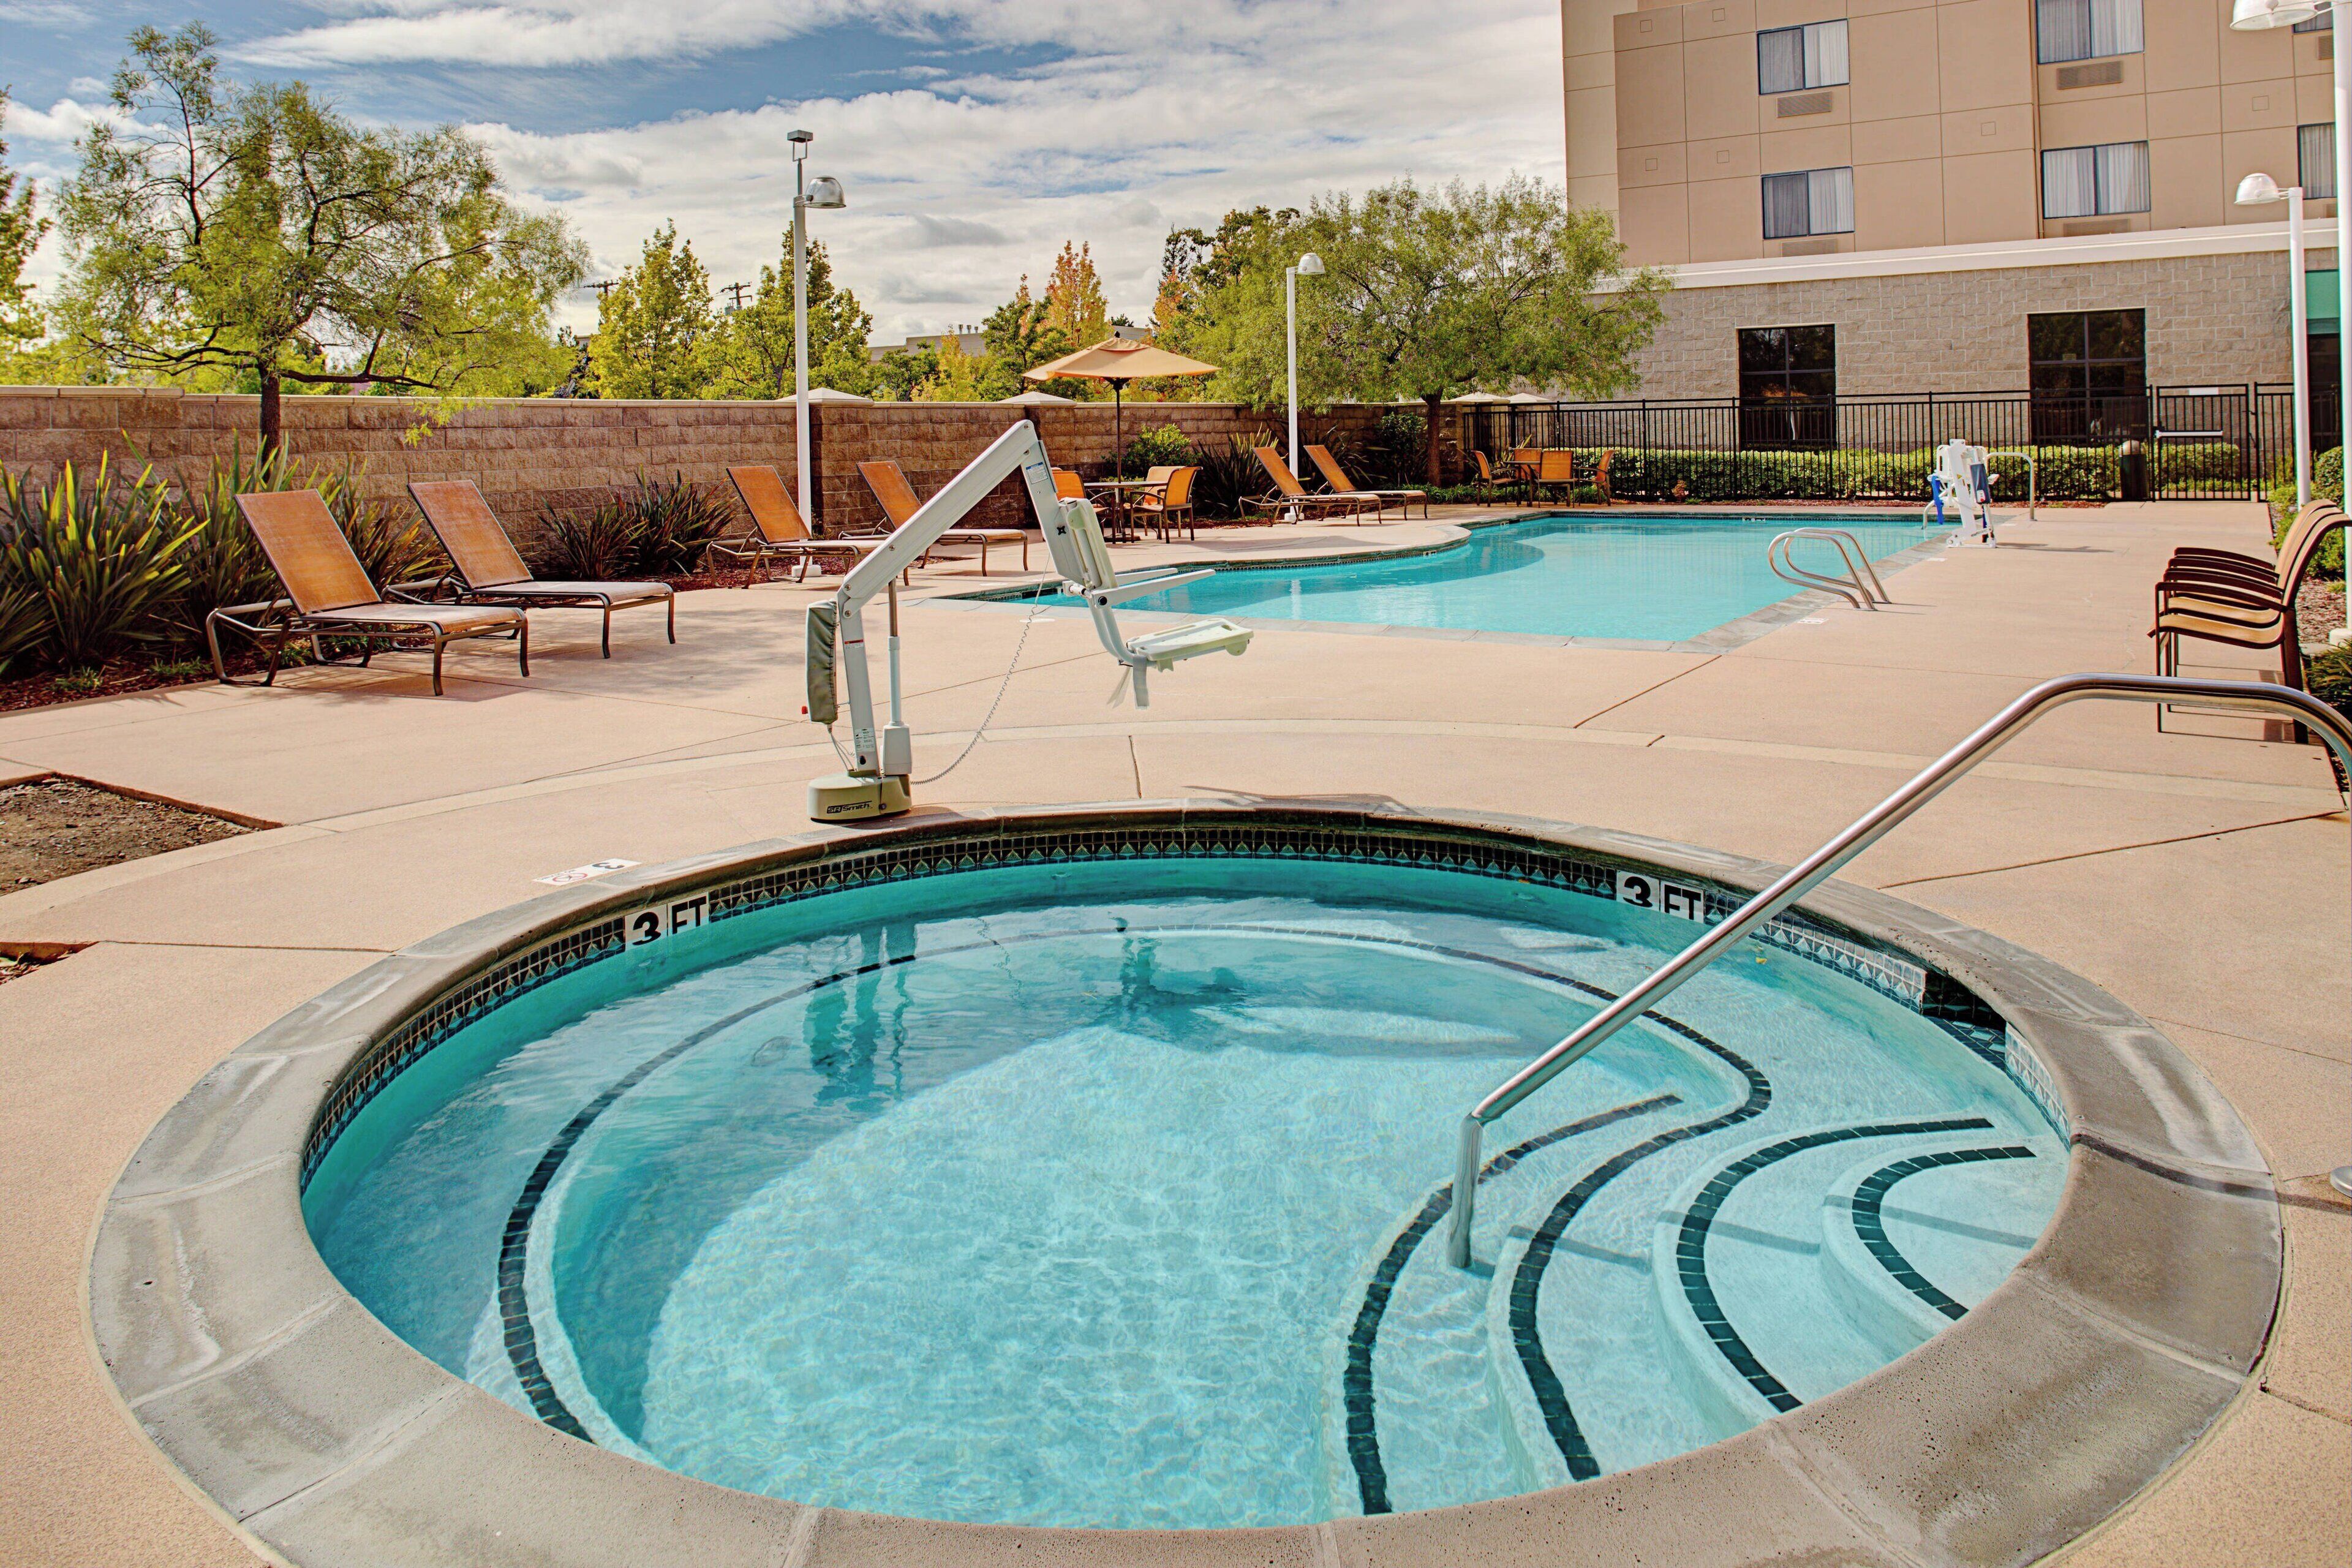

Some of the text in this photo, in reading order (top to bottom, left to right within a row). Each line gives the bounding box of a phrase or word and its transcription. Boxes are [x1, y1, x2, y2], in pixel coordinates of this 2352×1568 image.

[632, 895, 707, 946] 3 FT
[1623, 876, 1702, 920] 3 FT
